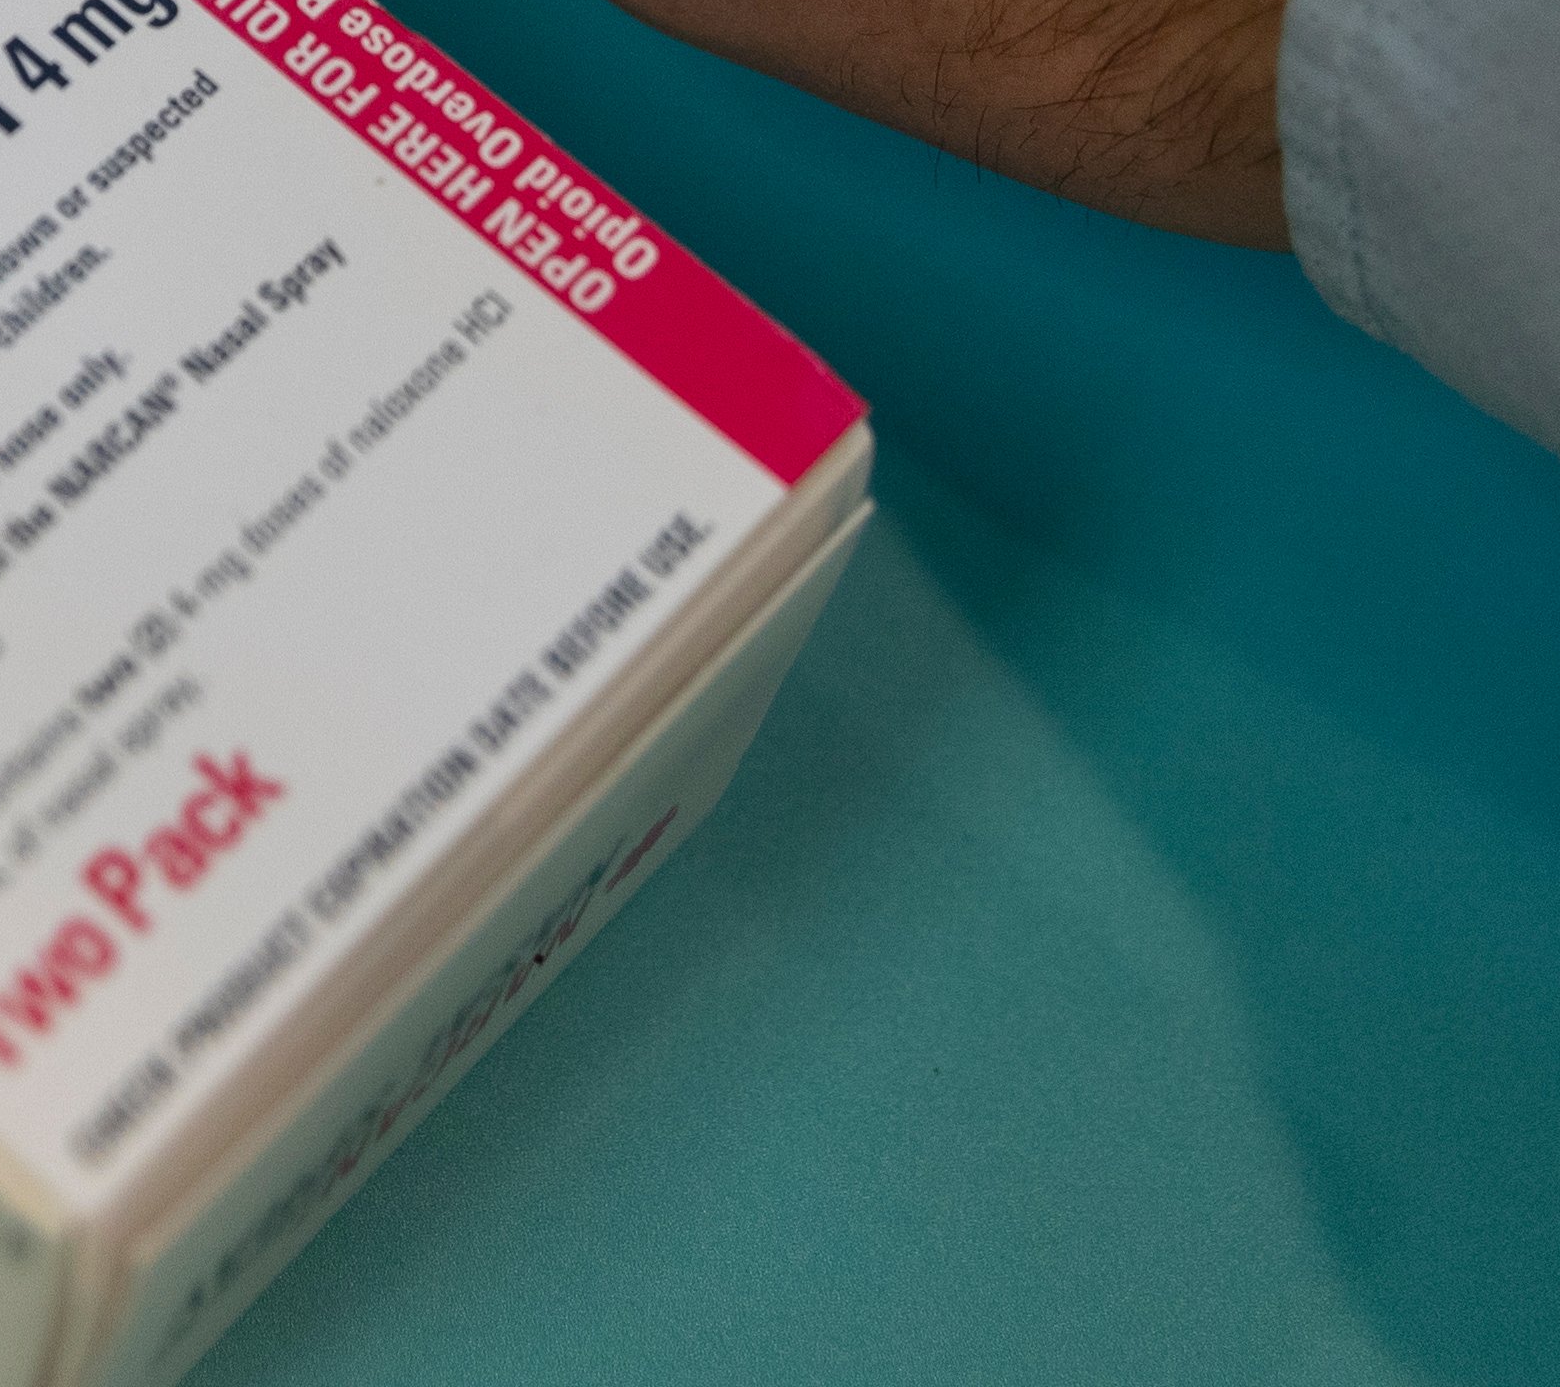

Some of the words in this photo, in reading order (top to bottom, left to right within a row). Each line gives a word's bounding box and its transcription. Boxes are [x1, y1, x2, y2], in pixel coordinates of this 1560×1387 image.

[3, 35, 70, 92] 4
[283, 32, 380, 117] FOR
[339, 7, 523, 169] Overdose
[56, 185, 90, 220] or
[87, 68, 220, 192] suspected
[367, 103, 494, 212] HERE
[482, 197, 616, 313] OPEN
[513, 156, 659, 280] Opioid
[180, 302, 268, 383] Nasal
[257, 238, 346, 312] Spray
[453, 290, 513, 345] HCl
[81, 752, 284, 933] Pack
